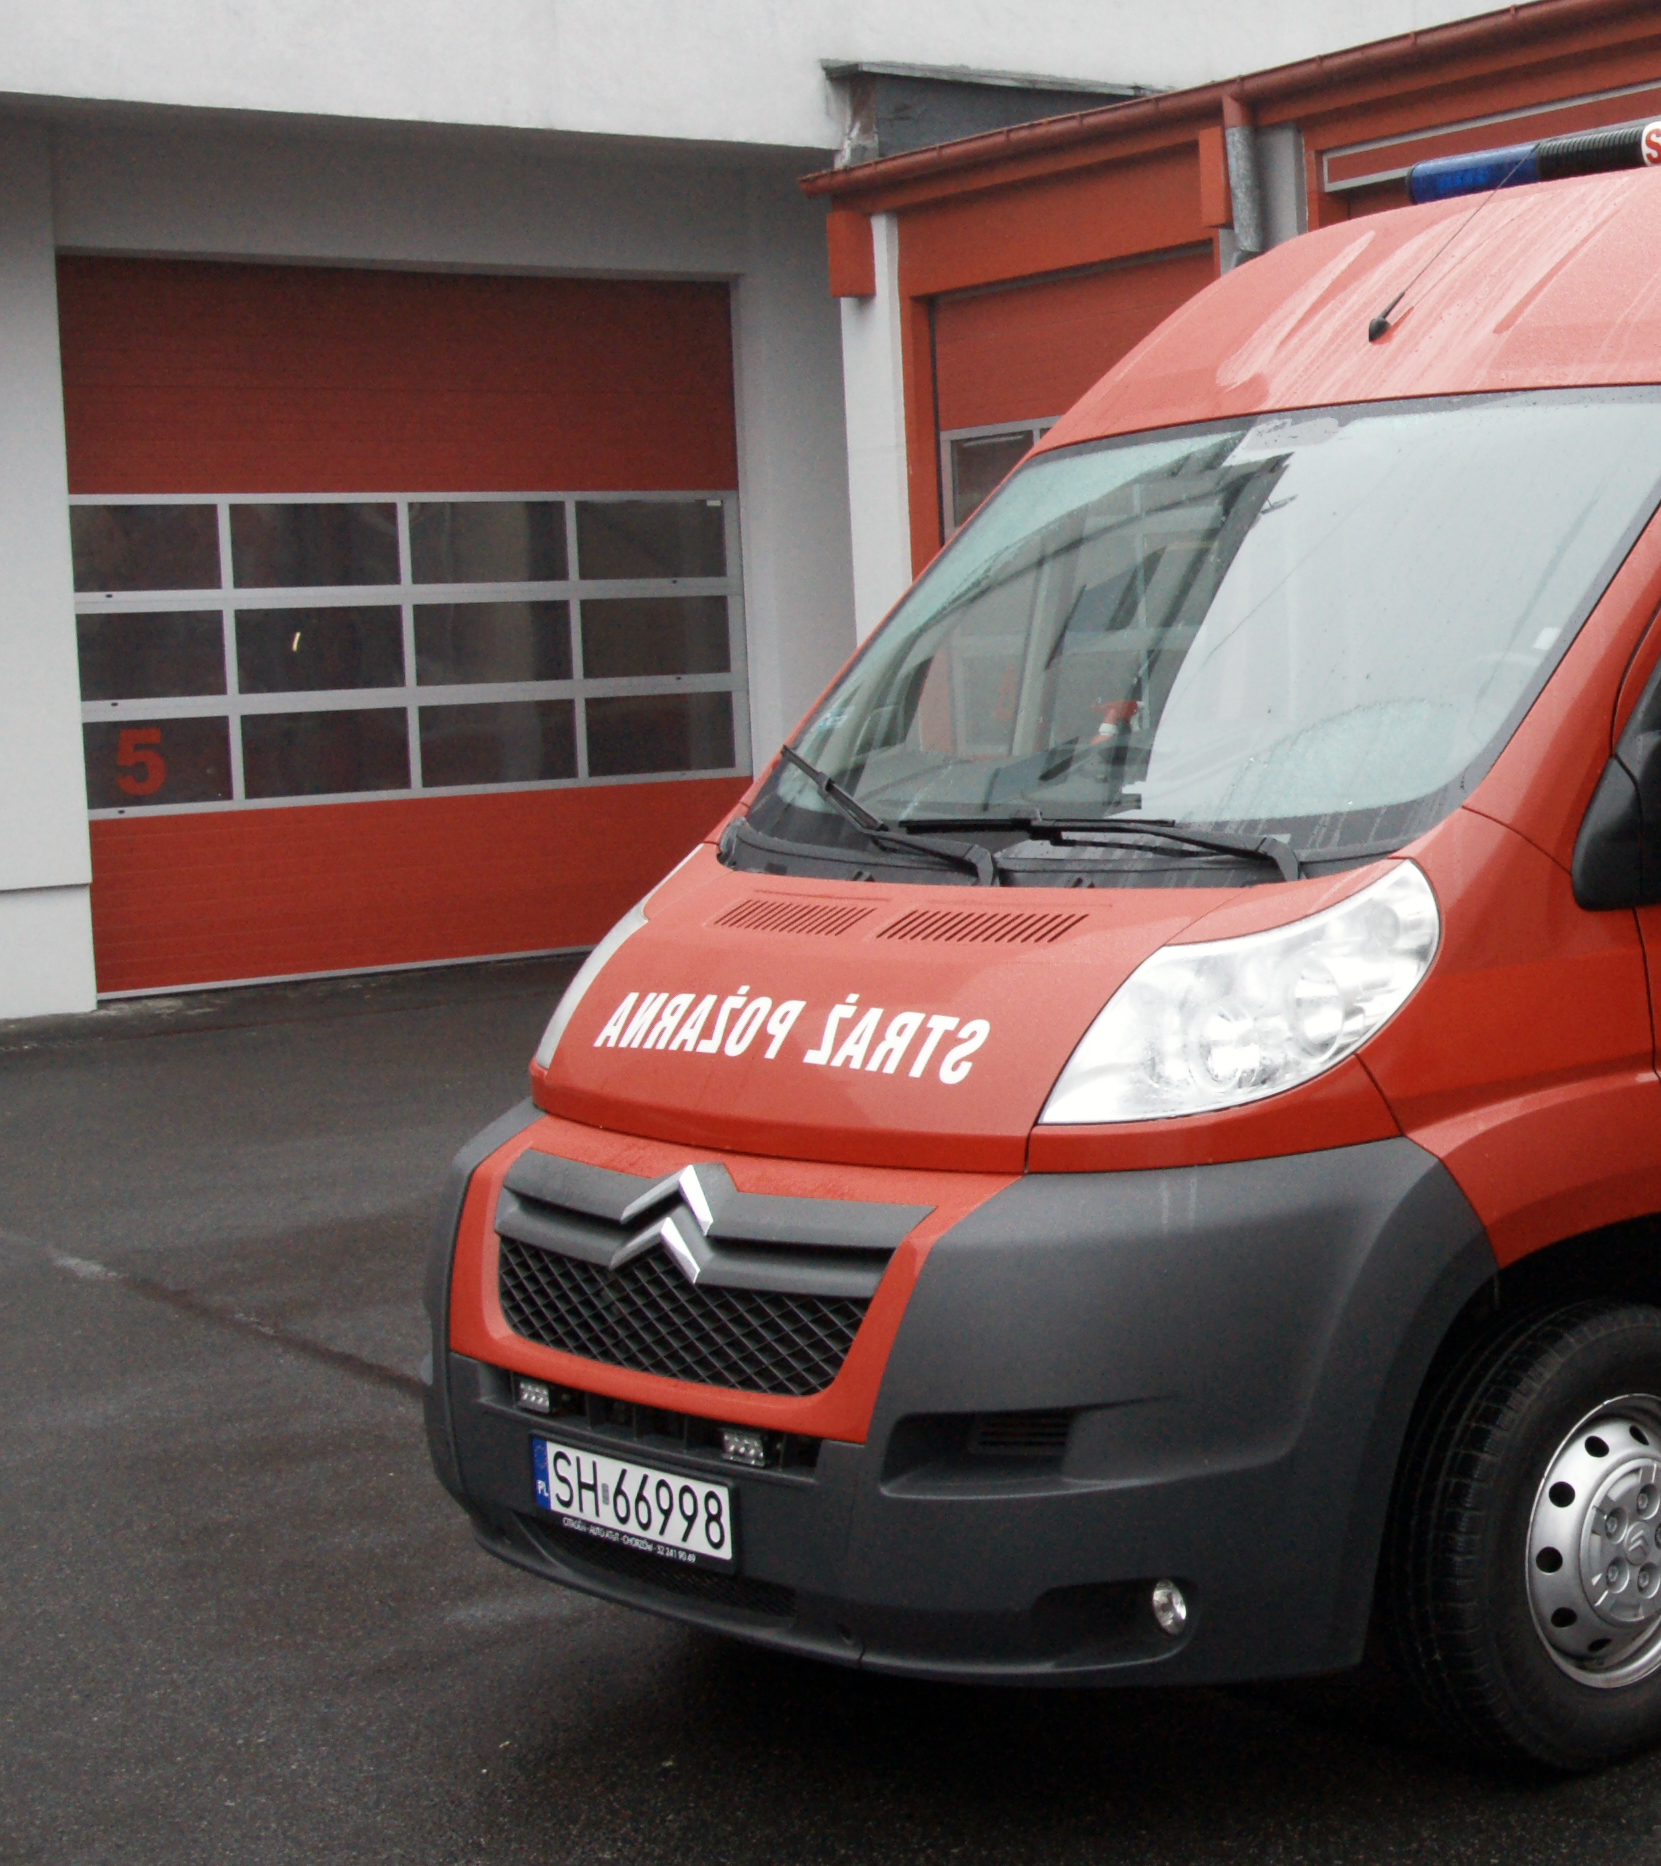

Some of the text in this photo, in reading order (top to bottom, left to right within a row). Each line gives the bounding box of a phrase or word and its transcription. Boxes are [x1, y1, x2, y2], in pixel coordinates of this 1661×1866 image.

[116, 727, 167, 796] 5
[537, 1479, 550, 1497] PL
[612, 1468, 726, 1550] 66998
